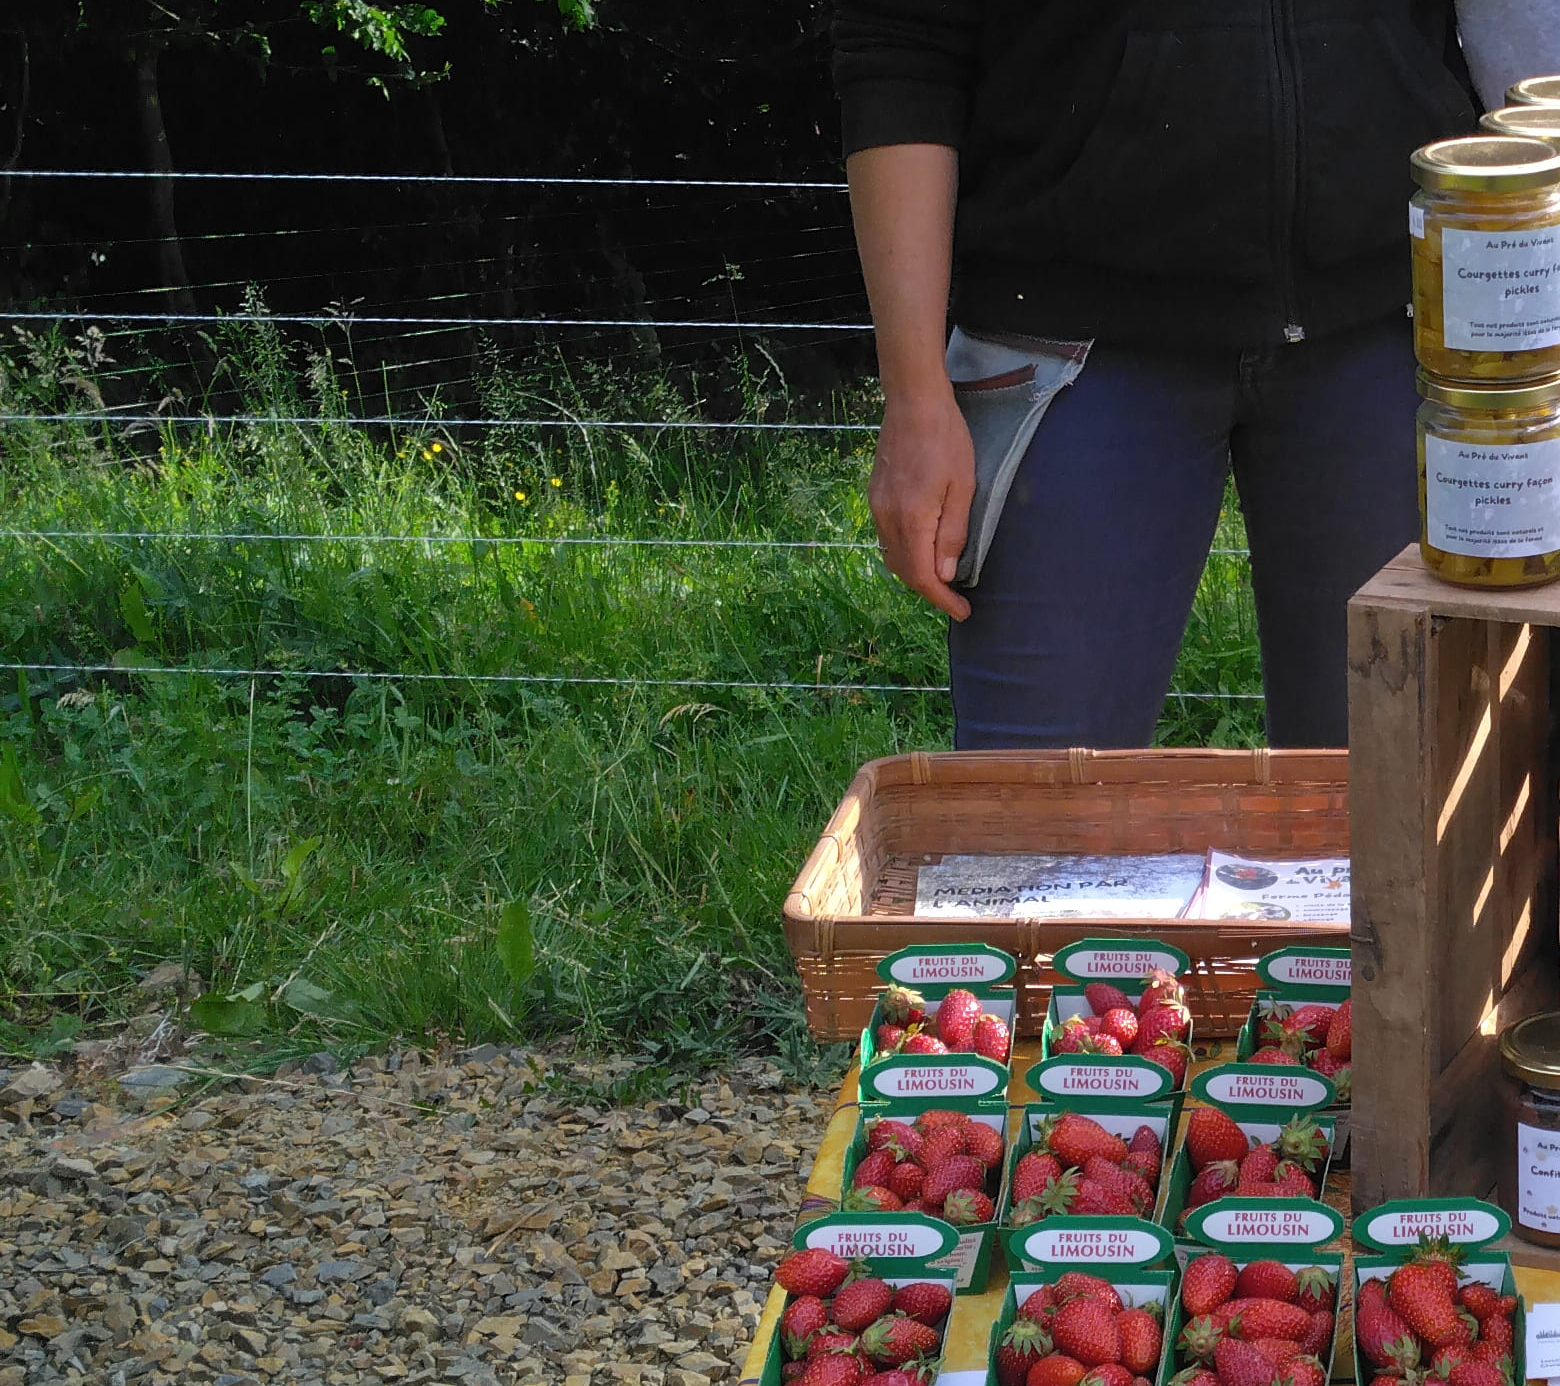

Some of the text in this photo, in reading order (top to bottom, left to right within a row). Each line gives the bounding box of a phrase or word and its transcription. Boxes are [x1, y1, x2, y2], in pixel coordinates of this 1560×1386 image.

[1458, 268, 1520, 282] Courgettes
[1524, 268, 1549, 279] curry
[1505, 285, 1540, 298] pickles
[1436, 472, 1490, 489] Courgettes
[1494, 477, 1523, 491] curry
[1475, 497, 1511, 507] pickles
[1080, 879, 1128, 890] PAR
[932, 894, 1052, 909] L'ANIMAL
[918, 955, 979, 967] FRUITS DU
[1093, 952, 1152, 962] FRUITS DU
[1294, 958, 1332, 968] FRUITS
[911, 965, 985, 978] LIMOUSIN
[1087, 961, 1158, 974] LIMOUSIN
[904, 1068, 968, 1079] FRUITS DU
[1070, 1066, 1133, 1078] FRUITS DU
[897, 1077, 975, 1091] LIMOUSIN
[1062, 1076, 1139, 1090] LIMOUSIN
[1235, 1076, 1298, 1088] FRUITS DU
[1229, 1084, 1305, 1099] LIMOUSIN
[1234, 1212, 1303, 1223] FRUITS DU
[1400, 1212, 1467, 1223] FRUITS DU
[1227, 1222, 1311, 1236] LIMOUSIN
[1393, 1223, 1475, 1237] LIMOUSIN
[837, 1233, 908, 1243] FRUITS DU
[1058, 1233, 1128, 1244] FRUITS DU
[829, 1243, 916, 1256] LIMOUSIN
[1050, 1244, 1136, 1259] LIMOUSIN
